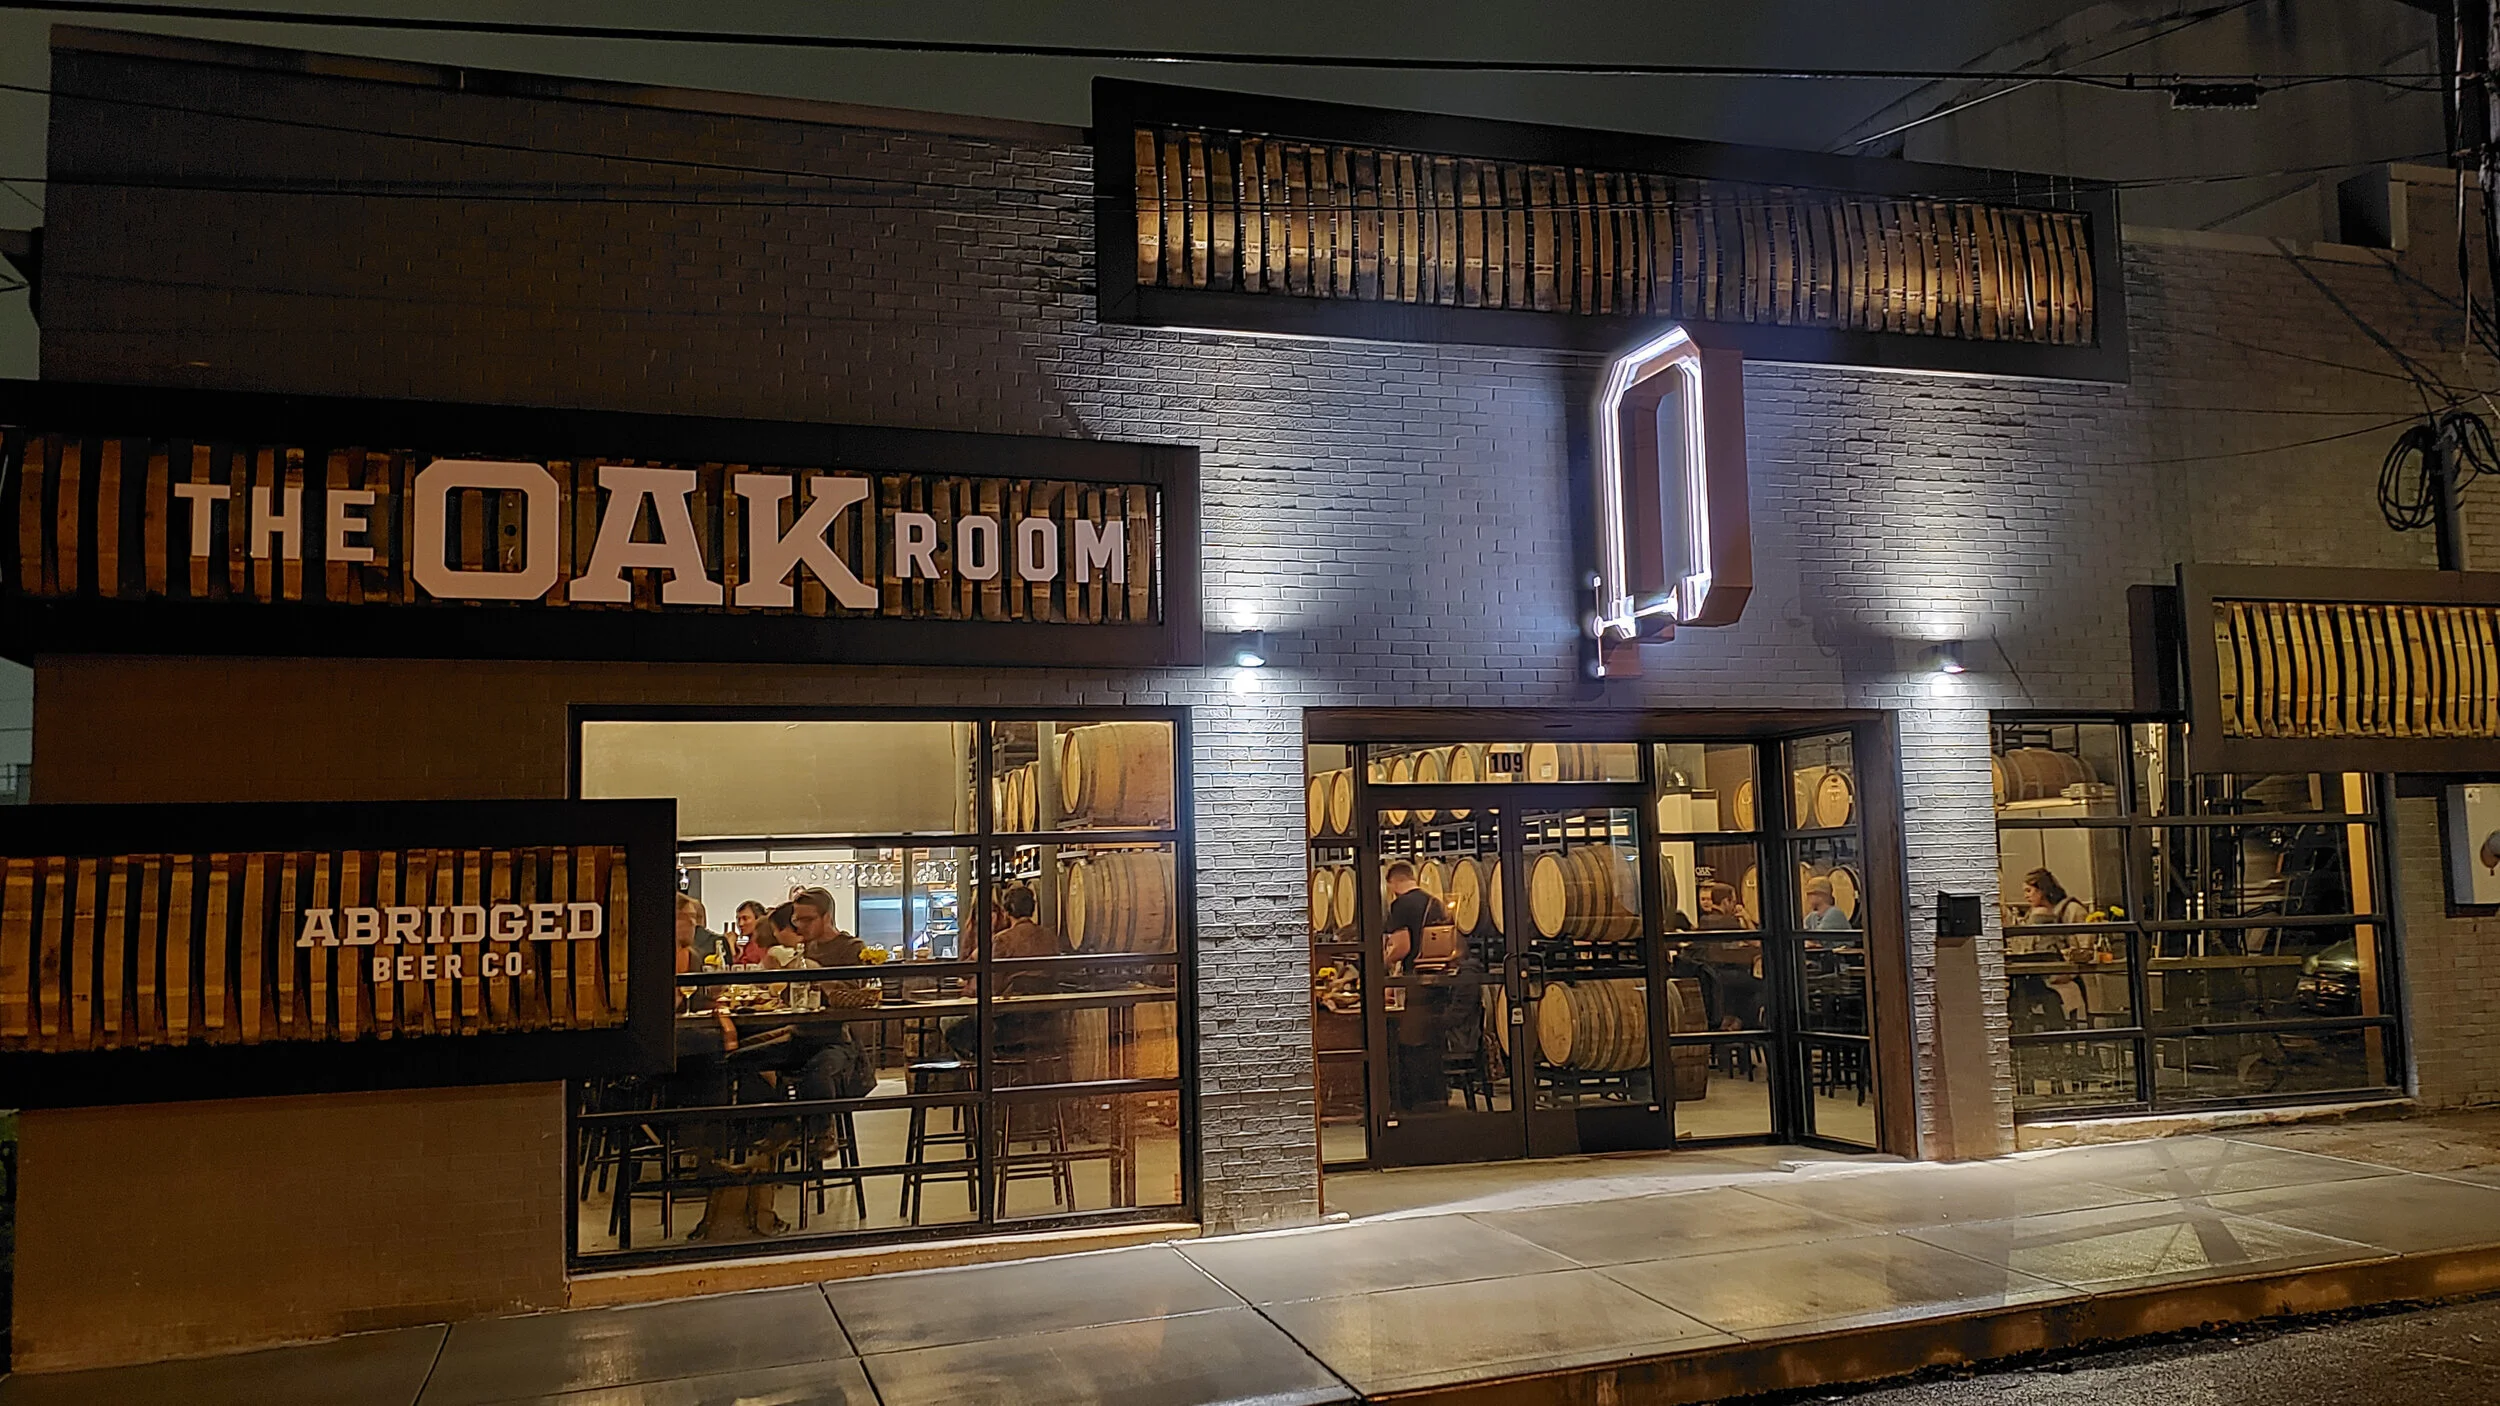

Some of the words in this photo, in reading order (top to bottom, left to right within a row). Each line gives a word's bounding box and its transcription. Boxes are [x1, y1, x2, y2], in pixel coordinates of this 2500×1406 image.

[174, 483, 375, 562] THE
[413, 459, 879, 609] OAK
[894, 512, 1124, 584] ROOM
[1490, 753, 1523, 773] 109
[296, 902, 603, 947] ABRIDGED
[373, 954, 463, 982] BEER
[482, 951, 535, 977] CO.
